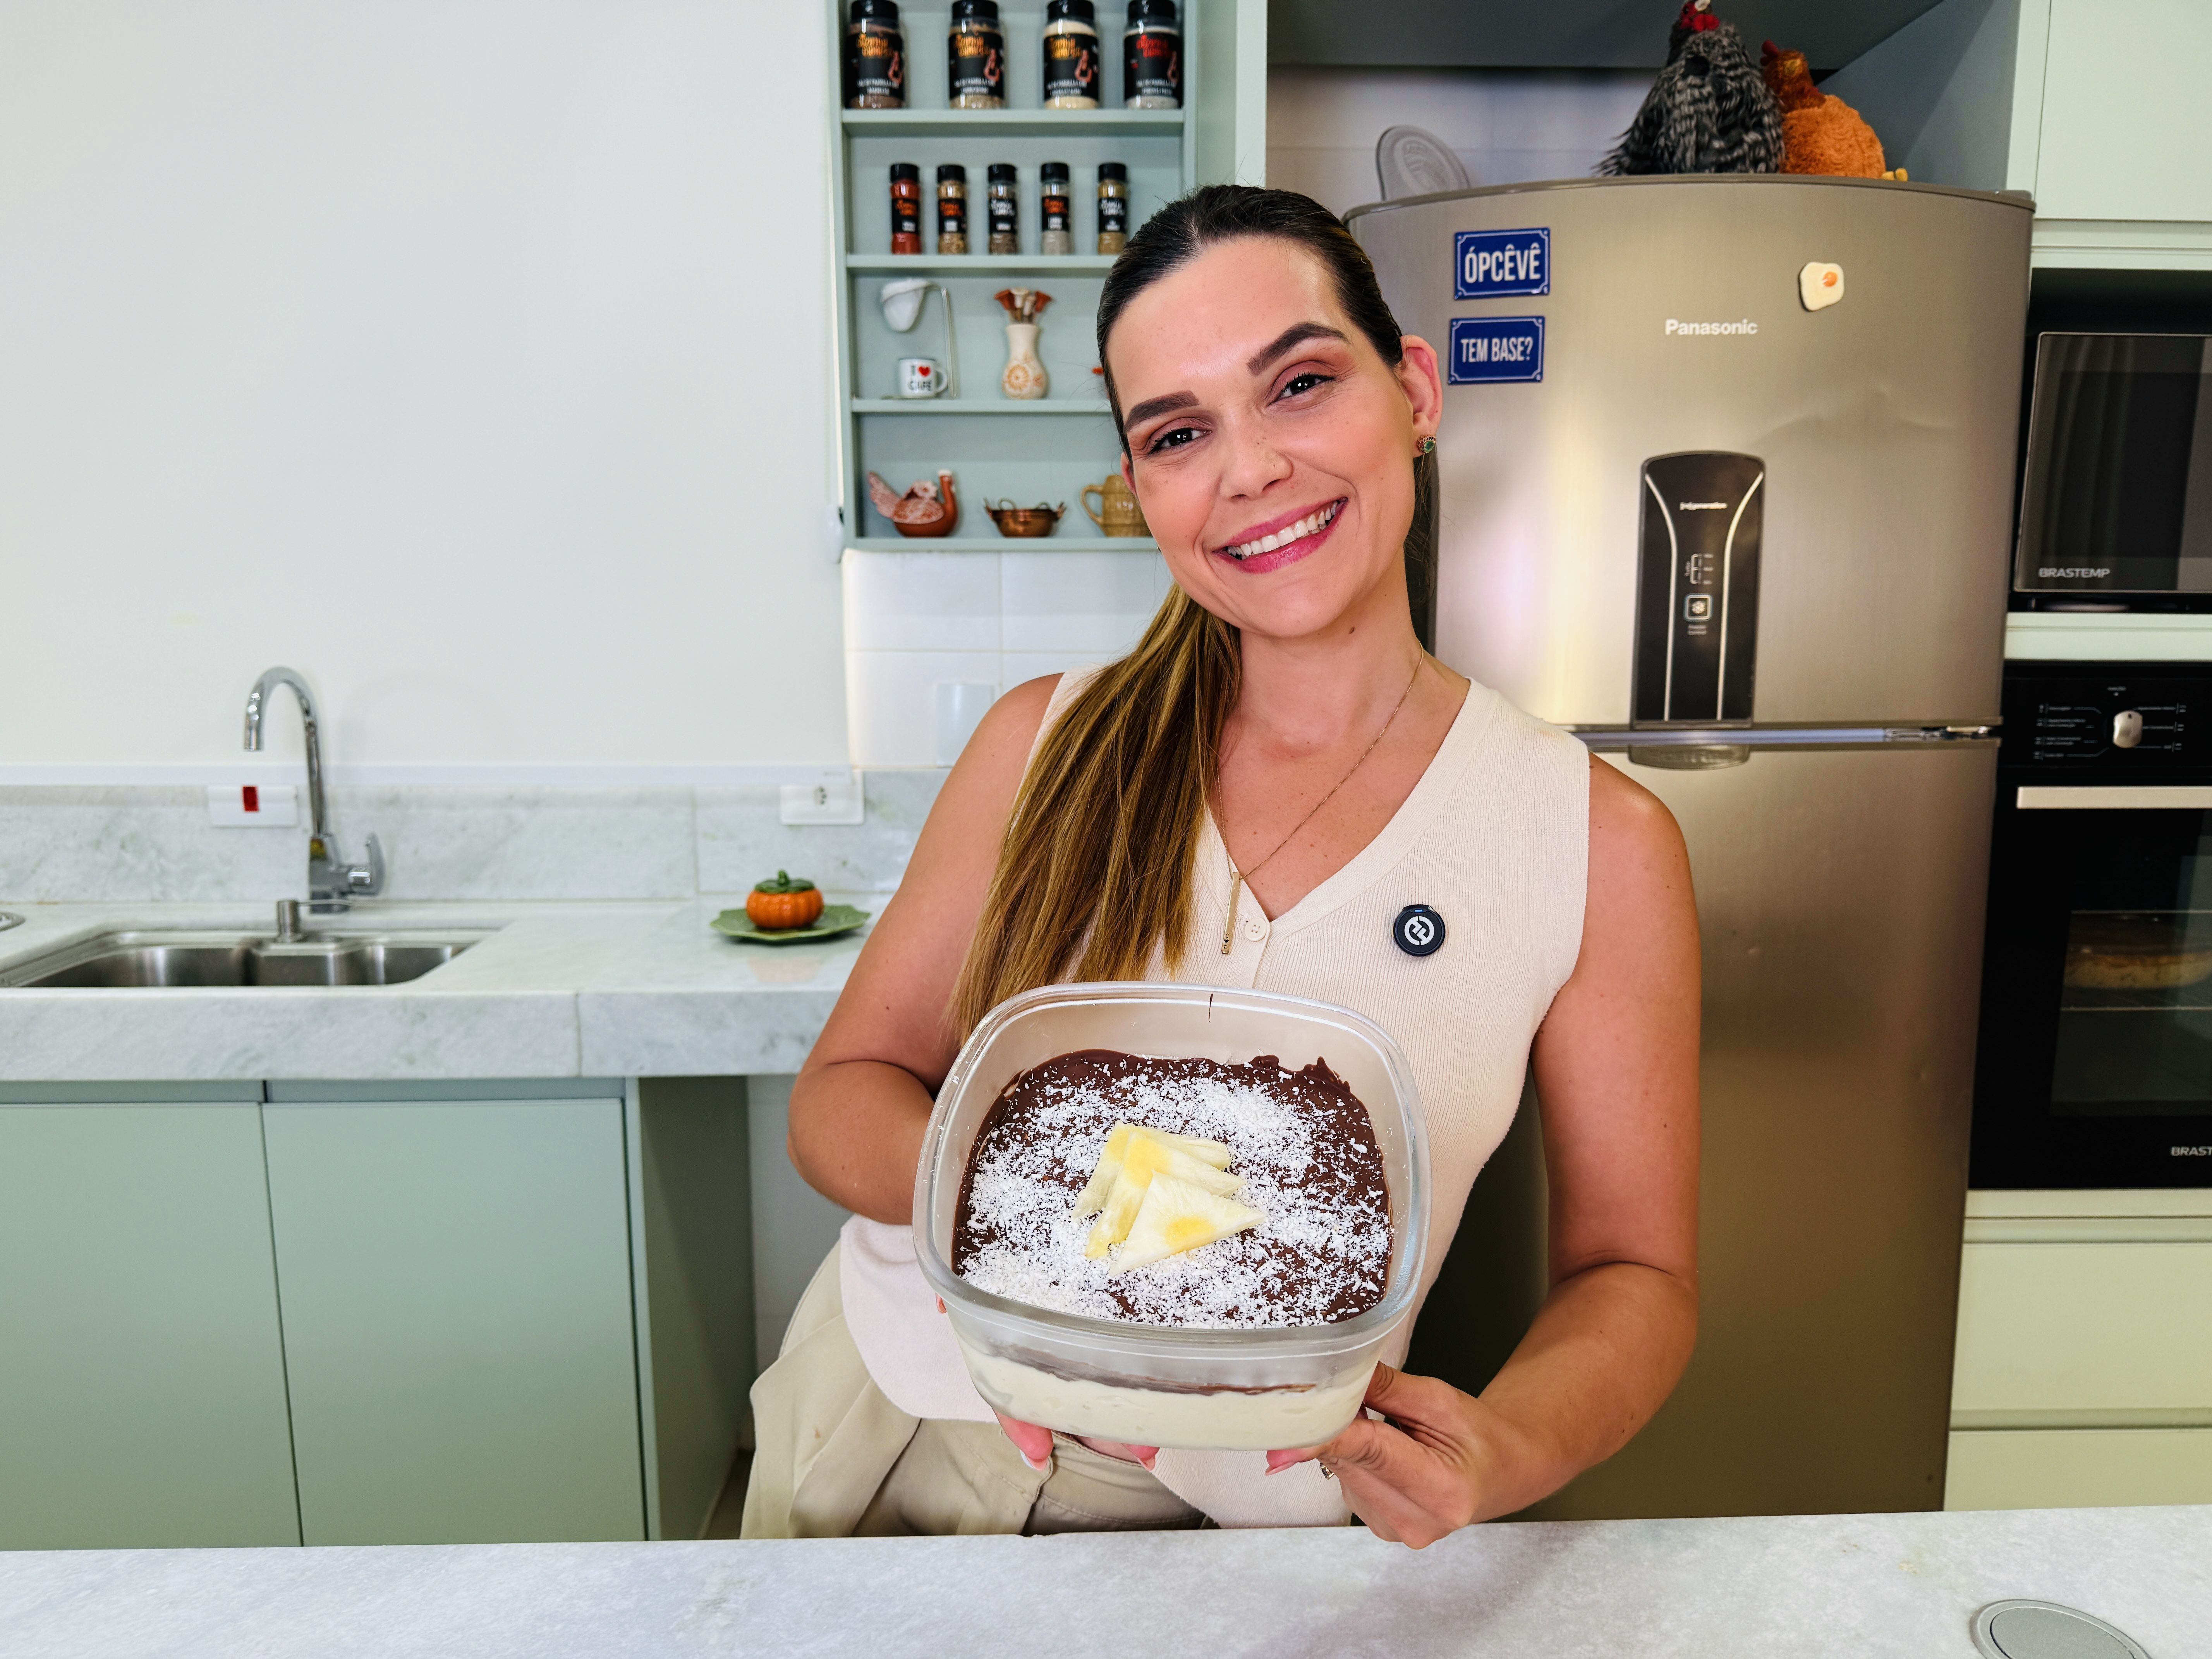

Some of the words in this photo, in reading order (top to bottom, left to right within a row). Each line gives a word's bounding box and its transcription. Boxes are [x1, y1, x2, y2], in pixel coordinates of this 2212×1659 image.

[1465, 242, 1540, 283] ÓPCÊVÊ
[1665, 318, 1758, 335] Panasonic
[1461, 338, 1488, 363] TEM
[1491, 337, 1533, 362] BASE?
[2039, 568, 2110, 578] BRASTEMP
[2171, 1146, 2212, 1156] BRAST
